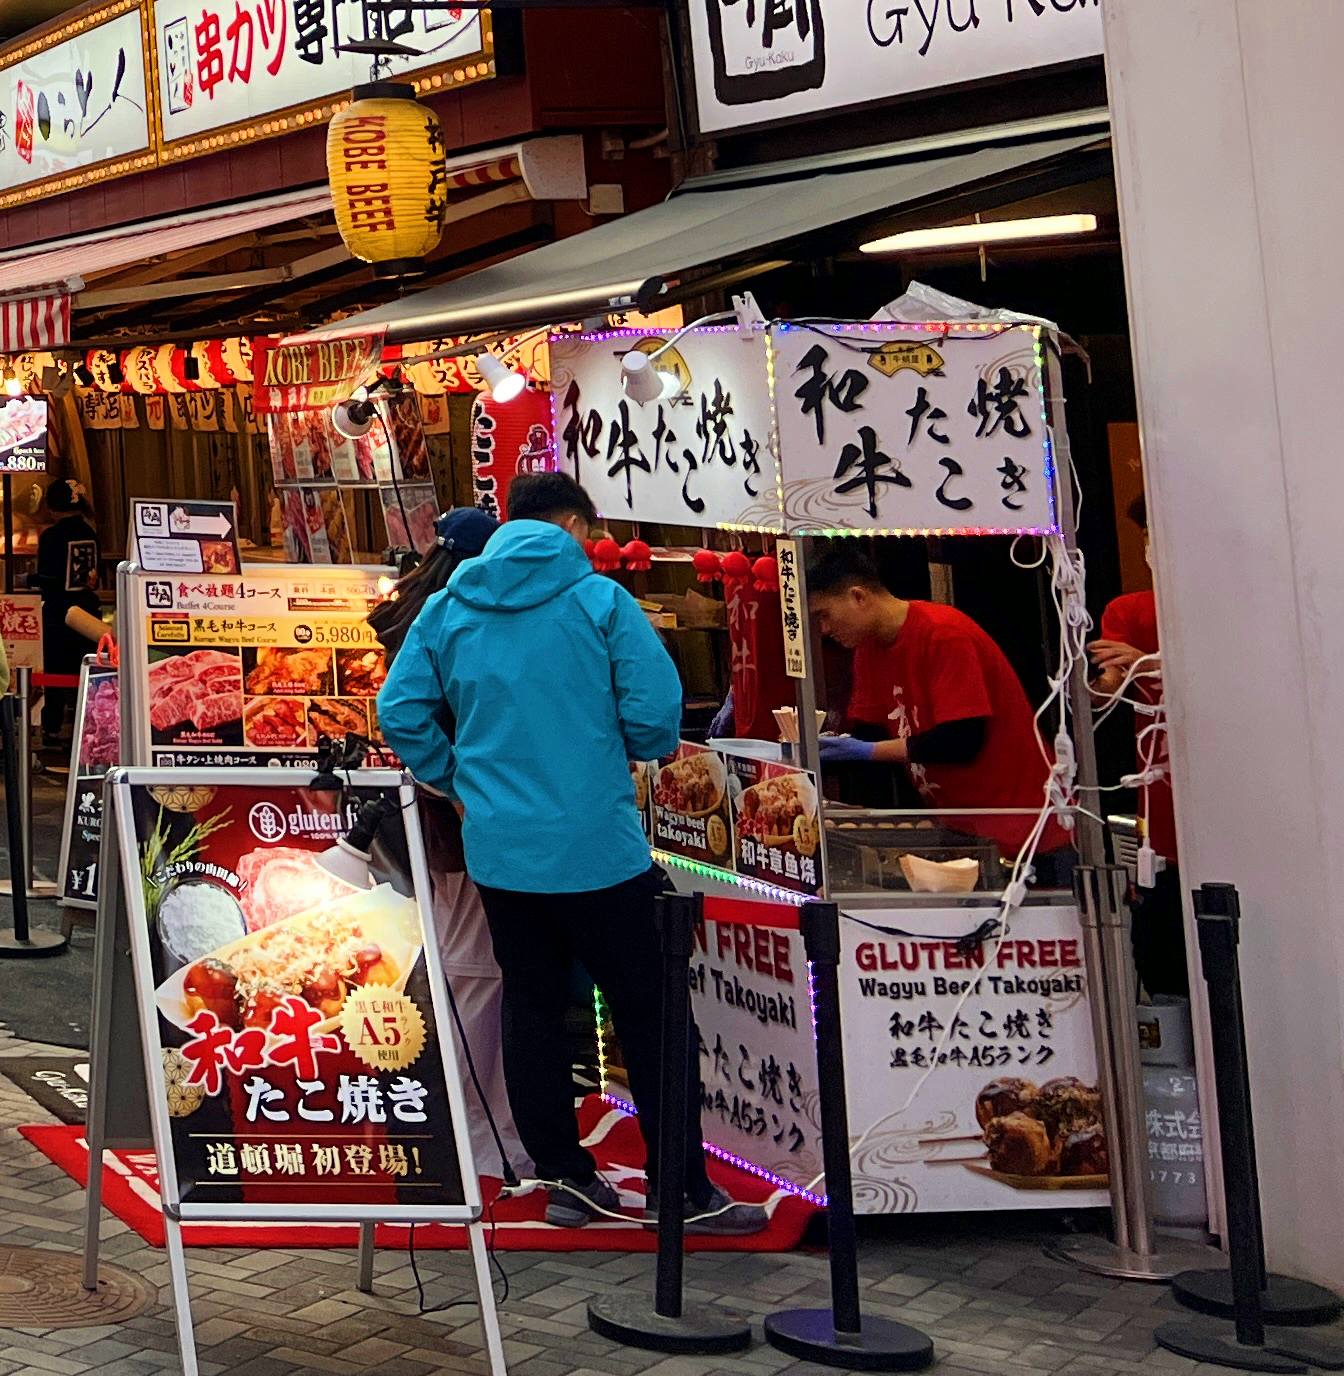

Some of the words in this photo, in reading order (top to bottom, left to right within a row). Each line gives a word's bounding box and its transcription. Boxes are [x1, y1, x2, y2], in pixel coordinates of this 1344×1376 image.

[743, 50, 796, 71] Gyu-Kaku
[342, 116, 387, 173] KOBE
[345, 182, 397, 233] BEEF
[561, 377, 761, 514] 和牛たこ焼き
[793, 343, 1032, 520] 和牛たこ焼き
[177, 581, 282, 600] 食べ放題4コース
[779, 547, 800, 642] 和牛たこ焼き
[193, 618, 278, 633] 黒毛和牛コース
[287, 807, 339, 837] gluten
[656, 823, 707, 850] takoyaki
[715, 921, 794, 984] FREE
[855, 940, 986, 972] GLUTEN
[995, 939, 1081, 969] FREE
[710, 967, 797, 1029] Takoyaki
[858, 977, 926, 1000] Wagyu
[988, 974, 1082, 997] Takoyaki
[359, 1015, 401, 1047] A5
[888, 1008, 1054, 1041] 和牛たこ焼き
[181, 996, 342, 1097] 和牛
[377, 1049, 399, 1062] 使用
[244, 1075, 429, 1124] たこ焼き
[206, 1142, 305, 1176] 道頓堀
[312, 1142, 423, 1177] 初登場!
